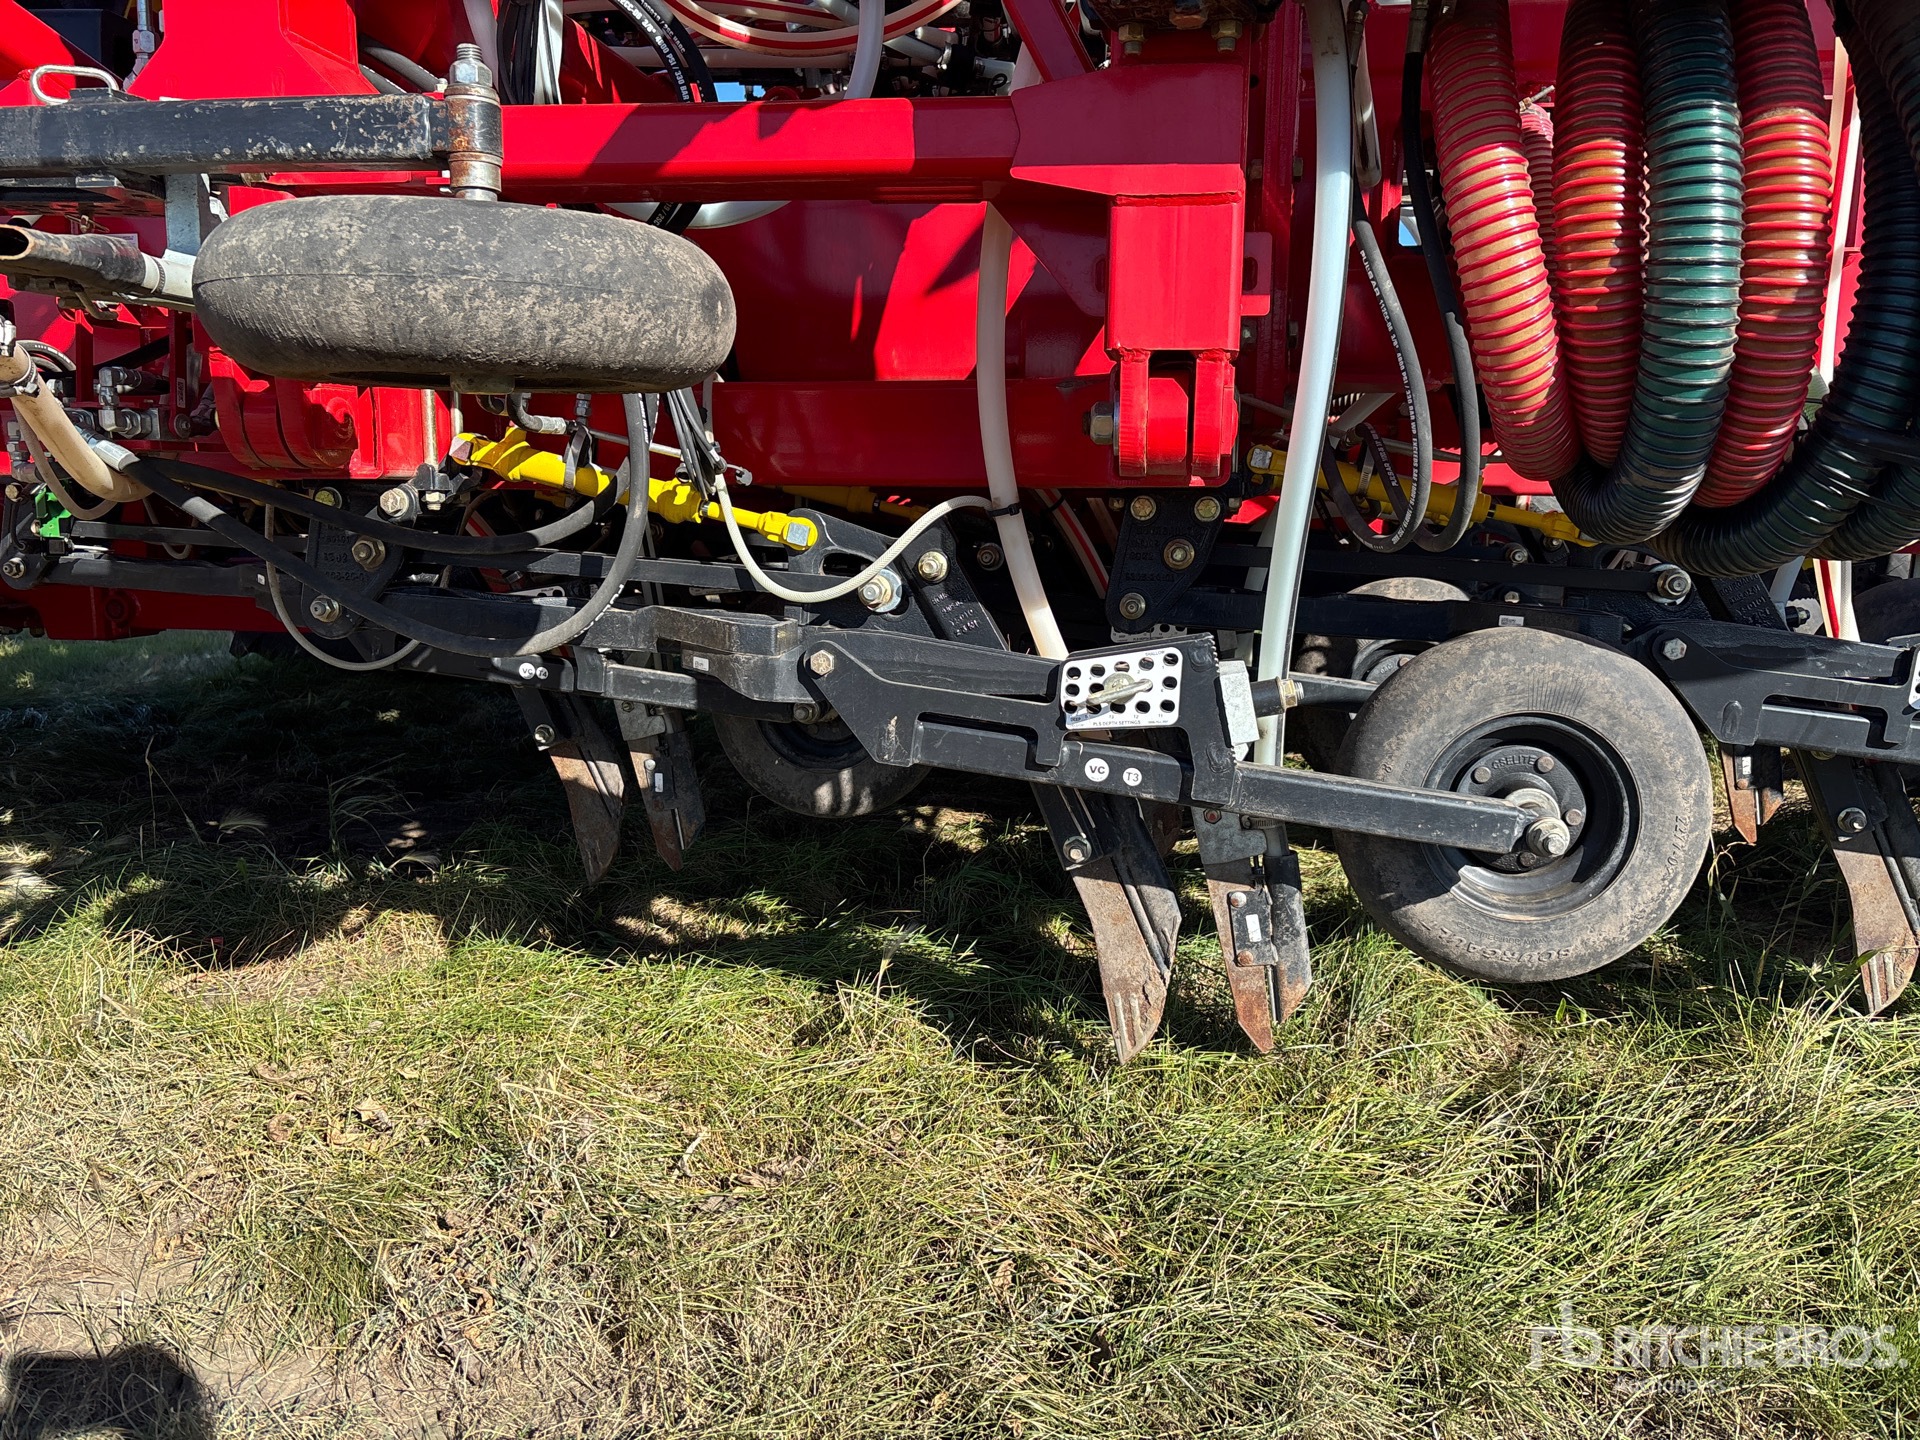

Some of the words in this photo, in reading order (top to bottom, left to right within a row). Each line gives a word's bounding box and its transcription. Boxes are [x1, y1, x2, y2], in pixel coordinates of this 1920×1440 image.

[666, 53, 677, 66] PSI
[674, 70, 685, 85] 330
[680, 85, 690, 101] BAR
[1360, 249, 1380, 297] PULSAR
[1401, 371, 1409, 384] PSI
[1405, 389, 1413, 404] 330
[522, 667, 533, 675] VC
[538, 669, 547, 677] T4
[1089, 765, 1106, 775] VC
[1125, 771, 1139, 782] T3
